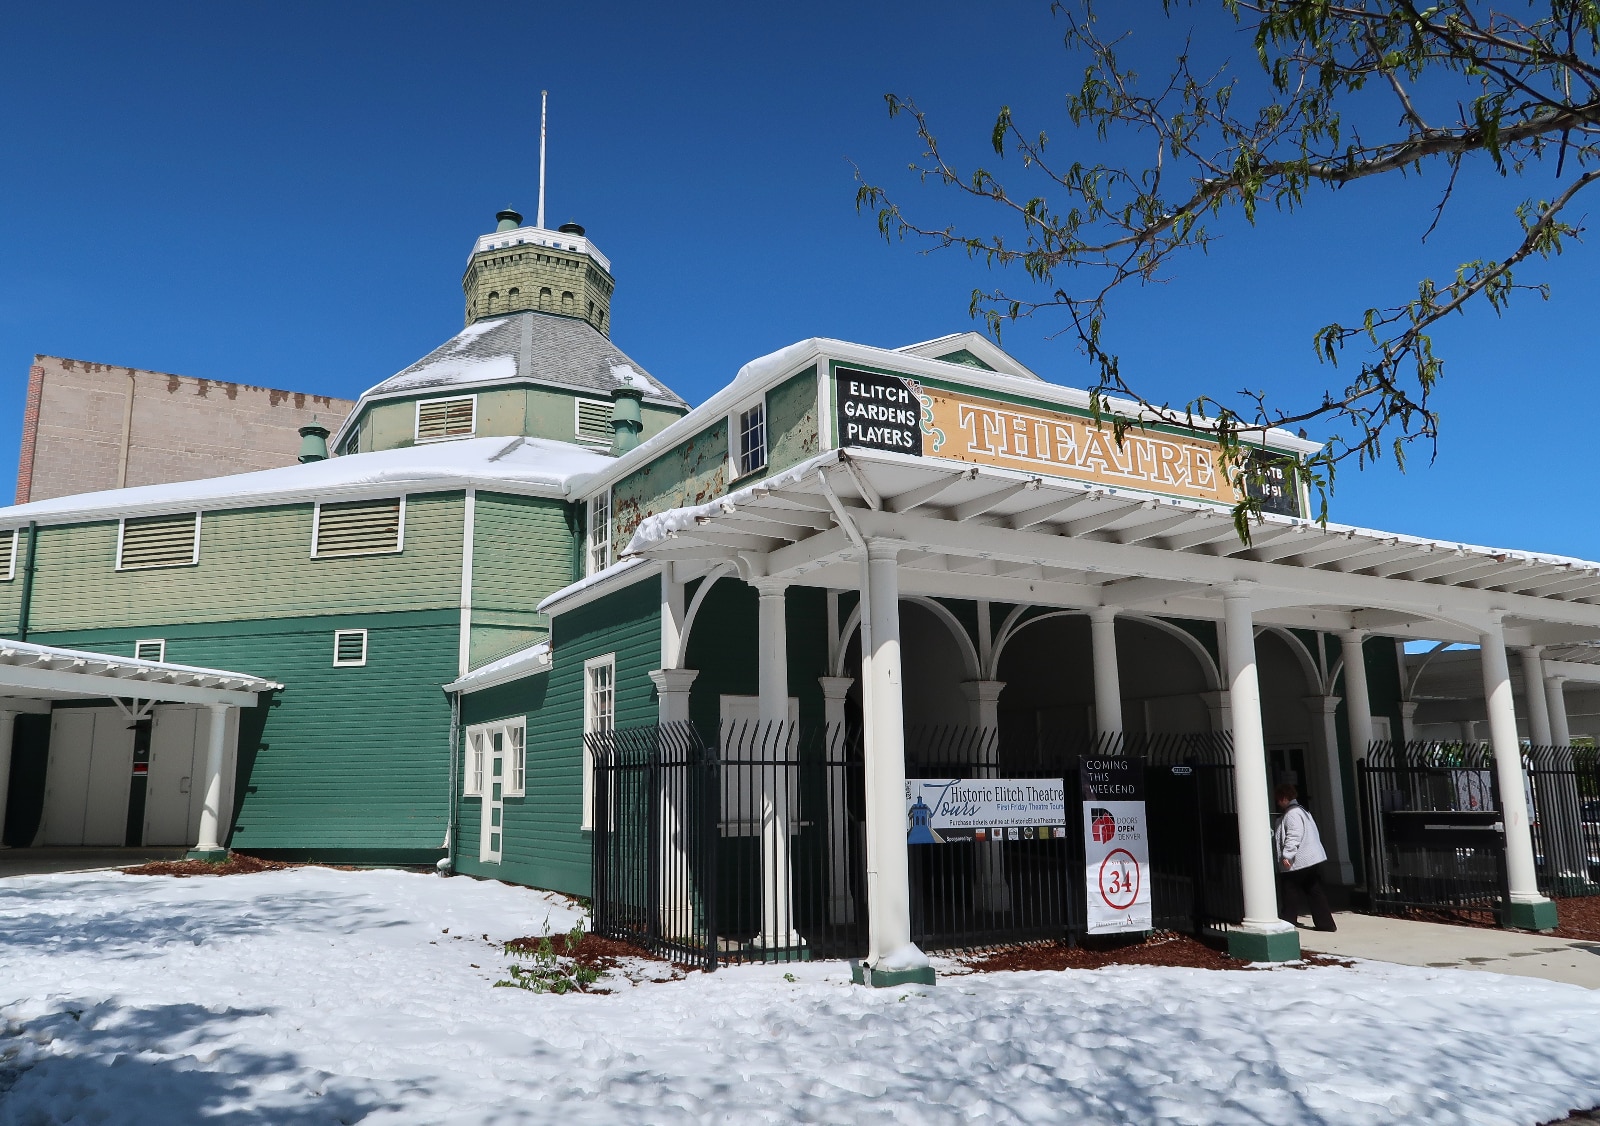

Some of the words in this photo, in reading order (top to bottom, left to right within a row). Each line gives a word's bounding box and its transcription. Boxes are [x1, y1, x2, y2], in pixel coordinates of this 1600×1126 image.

[849, 381, 909, 404] ELITCH
[844, 401, 916, 426] GARDENS
[847, 423, 913, 448] PLAYERS
[958, 403, 1217, 492] THEATRE
[1261, 483, 1282, 498] 1891
[1086, 760, 1128, 770] COMING
[1088, 772, 1110, 782] THIS
[950, 786, 992, 803] Historic
[994, 786, 1024, 802] Elitch
[1025, 786, 1064, 802] Theatre
[1089, 784, 1135, 794] WEEKEND
[923, 779, 981, 819] Tours
[996, 803, 1010, 811] First
[1010, 803, 1027, 813] Friday
[1028, 803, 1048, 811] Theatre
[1116, 817, 1138, 825] DOORS
[1117, 825, 1135, 833] OPEN
[1108, 870, 1132, 894] 34
